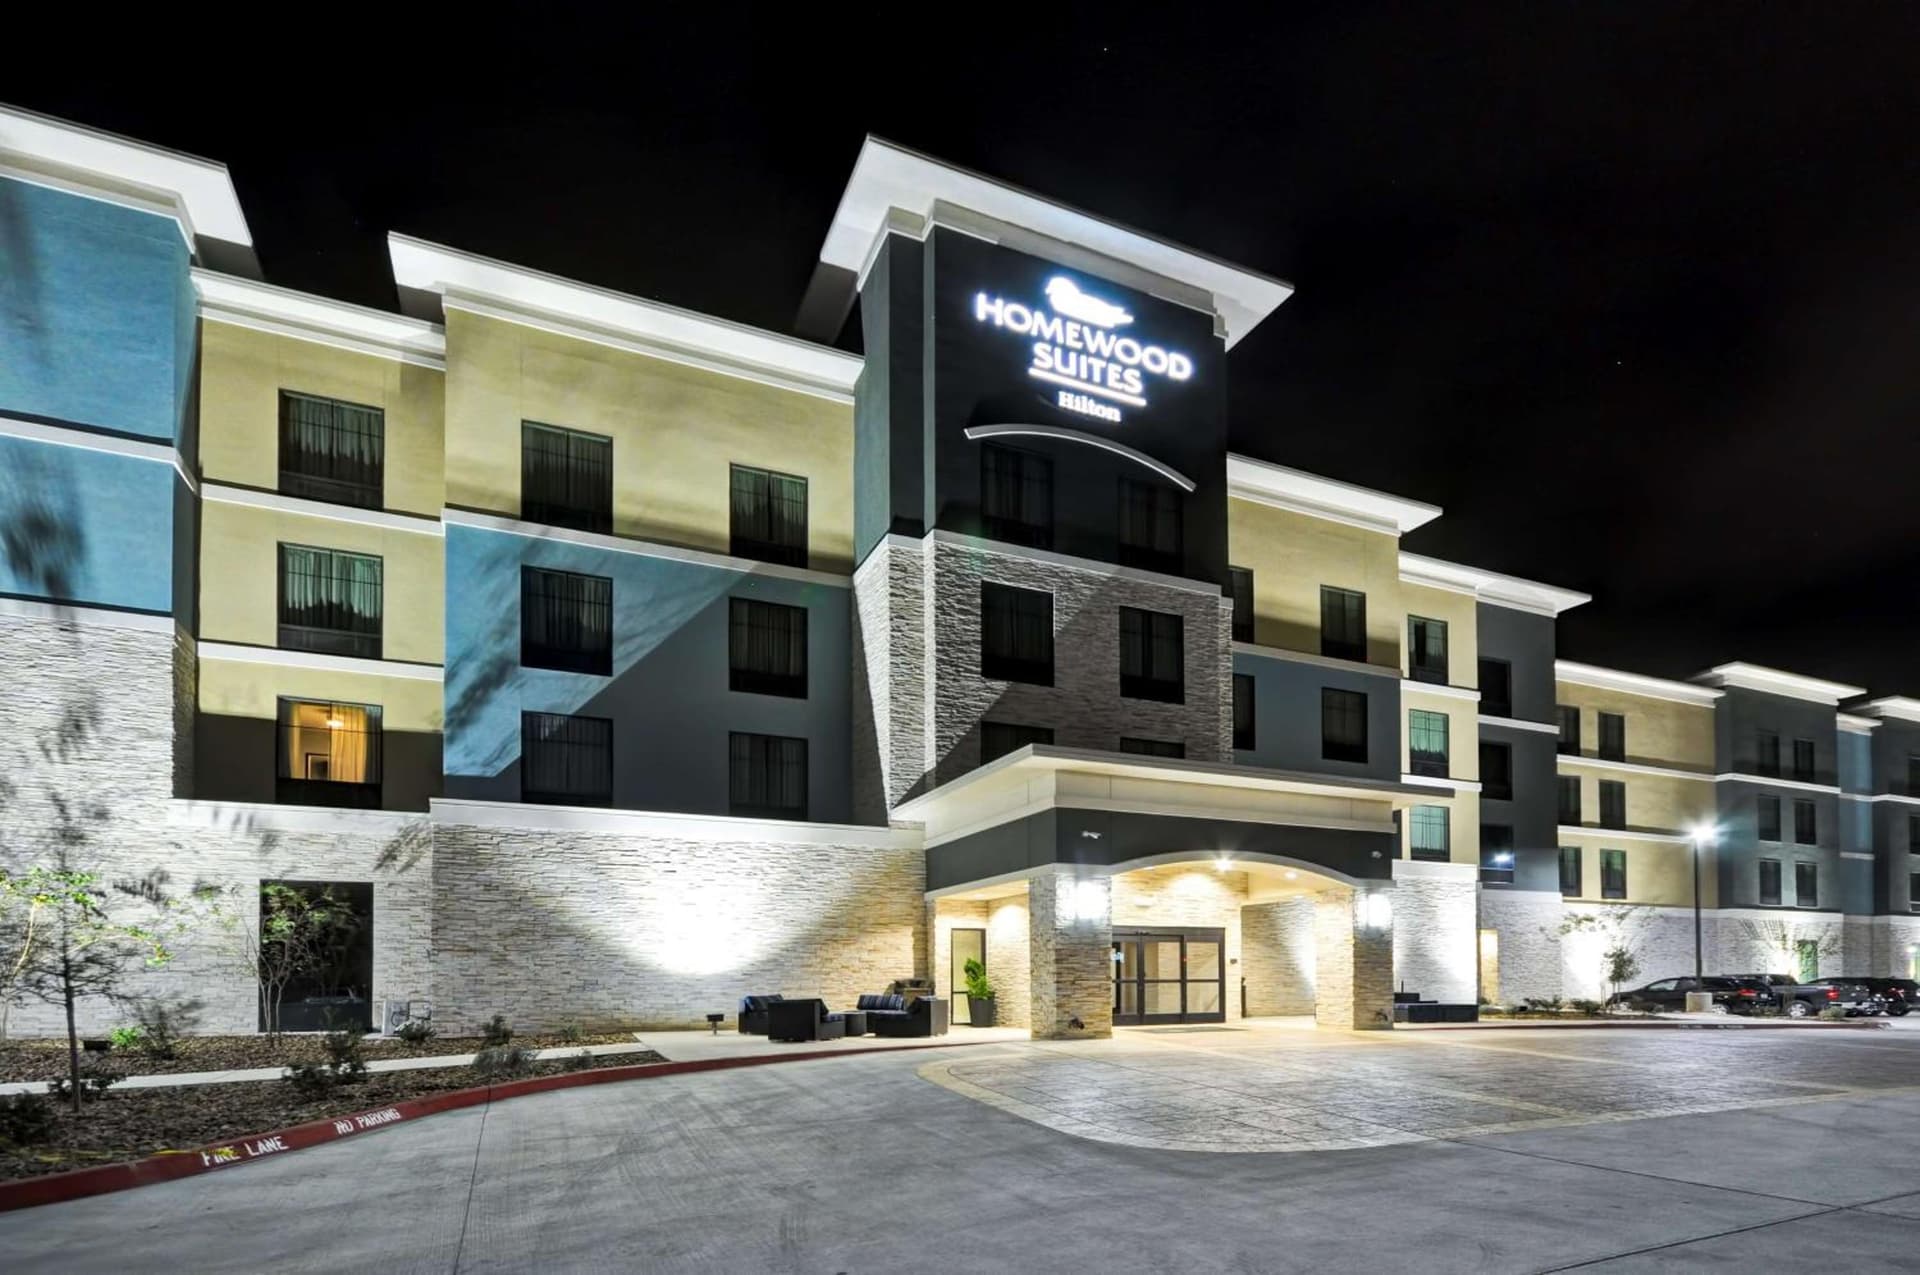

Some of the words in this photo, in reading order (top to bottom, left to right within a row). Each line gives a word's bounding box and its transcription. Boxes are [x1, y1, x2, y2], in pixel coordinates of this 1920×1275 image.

[974, 292, 1193, 380] HOMEWOOD
[1033, 343, 1143, 394] SUITES
[1058, 391, 1122, 422] Hilton
[333, 1119, 354, 1135] NO
[355, 1108, 402, 1128] PARKING
[244, 1136, 290, 1156] LANE
